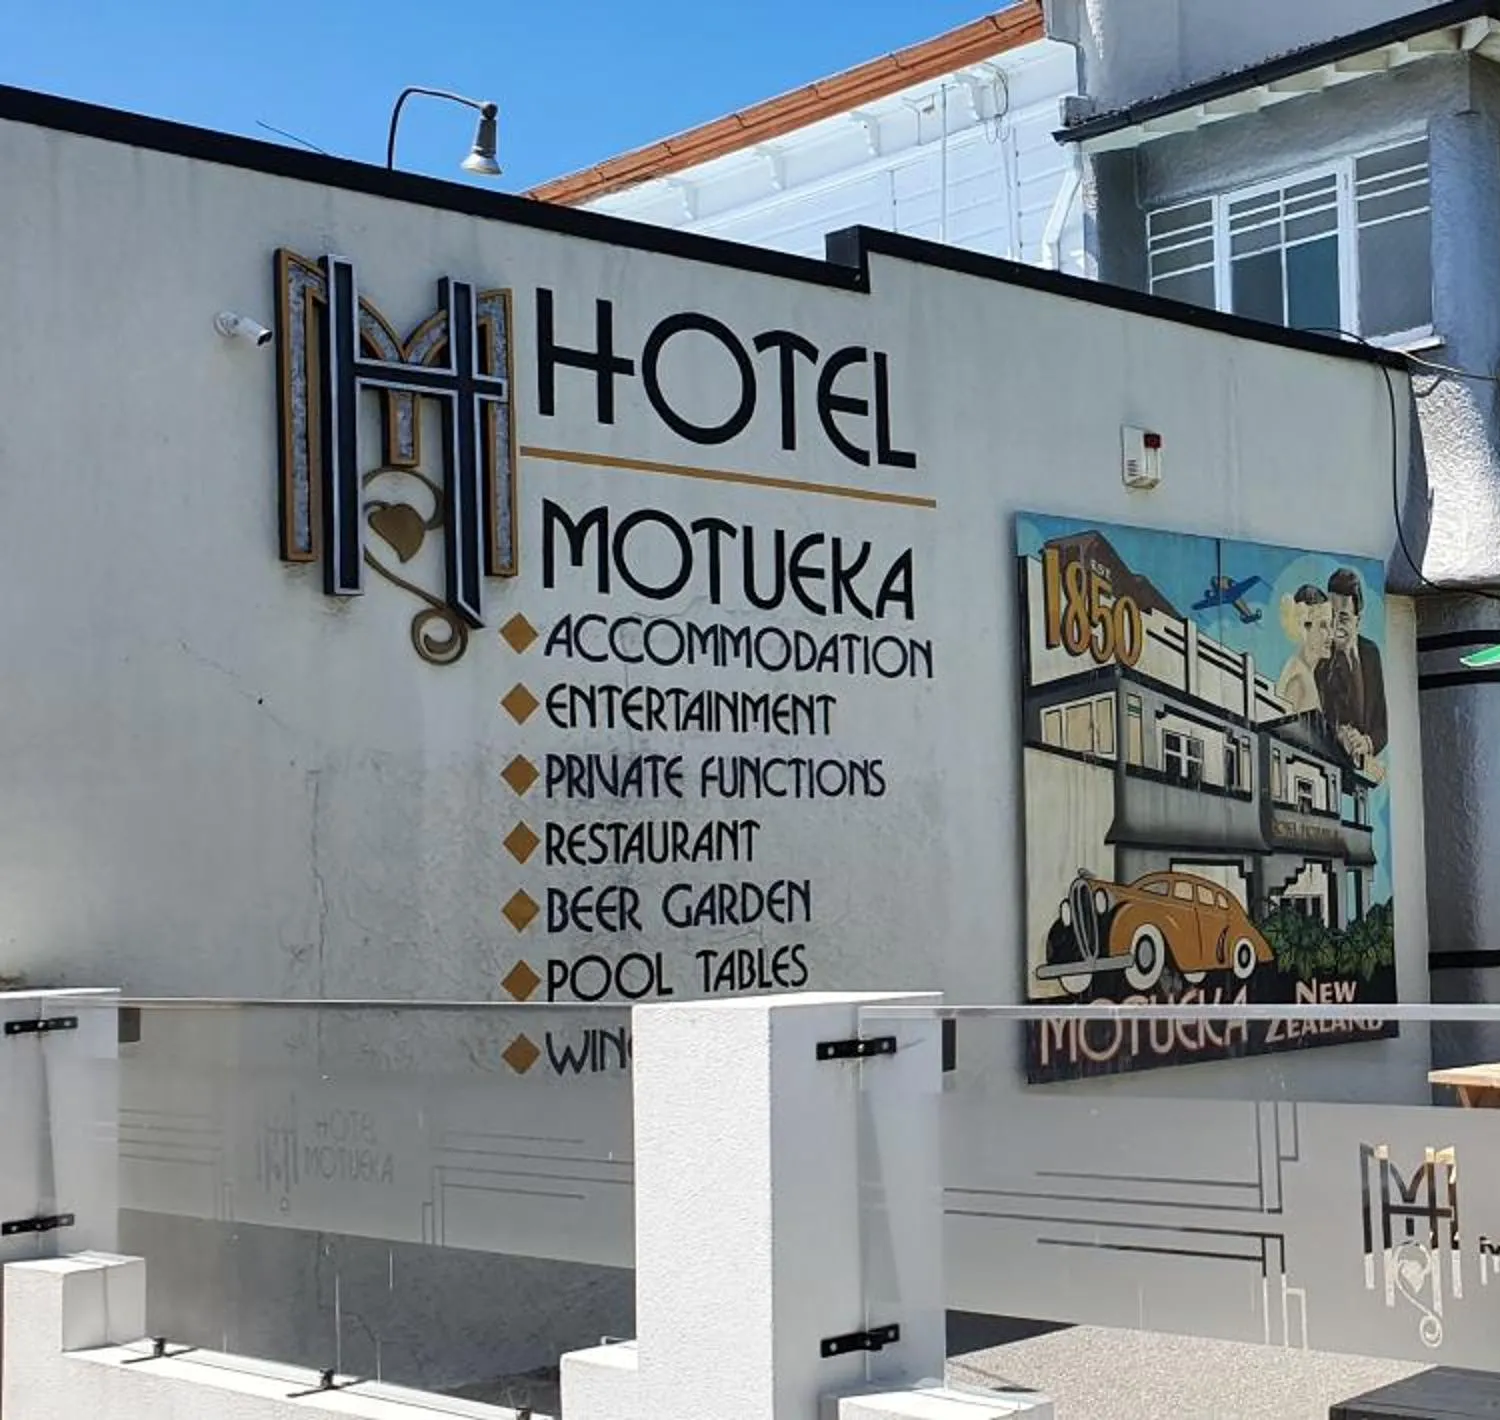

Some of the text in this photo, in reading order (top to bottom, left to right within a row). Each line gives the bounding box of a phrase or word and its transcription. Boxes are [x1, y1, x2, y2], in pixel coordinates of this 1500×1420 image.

[536, 287, 917, 469] HOTEL
[542, 498, 914, 620] MOTUEKA
[1042, 546, 1143, 667] 1850
[543, 613, 934, 679] ACCOMMODATION
[544, 683, 837, 735] ENTERTAINMENT
[545, 753, 887, 799] PRIVATE FUNCTIONS
[545, 819, 761, 865] RESTAURANT
[547, 880, 812, 933] BEER GARDEN
[547, 944, 809, 1003] POOL TABLES
[545, 1027, 634, 1076] WIN
[1039, 985, 1249, 1066] MOTUEKA
